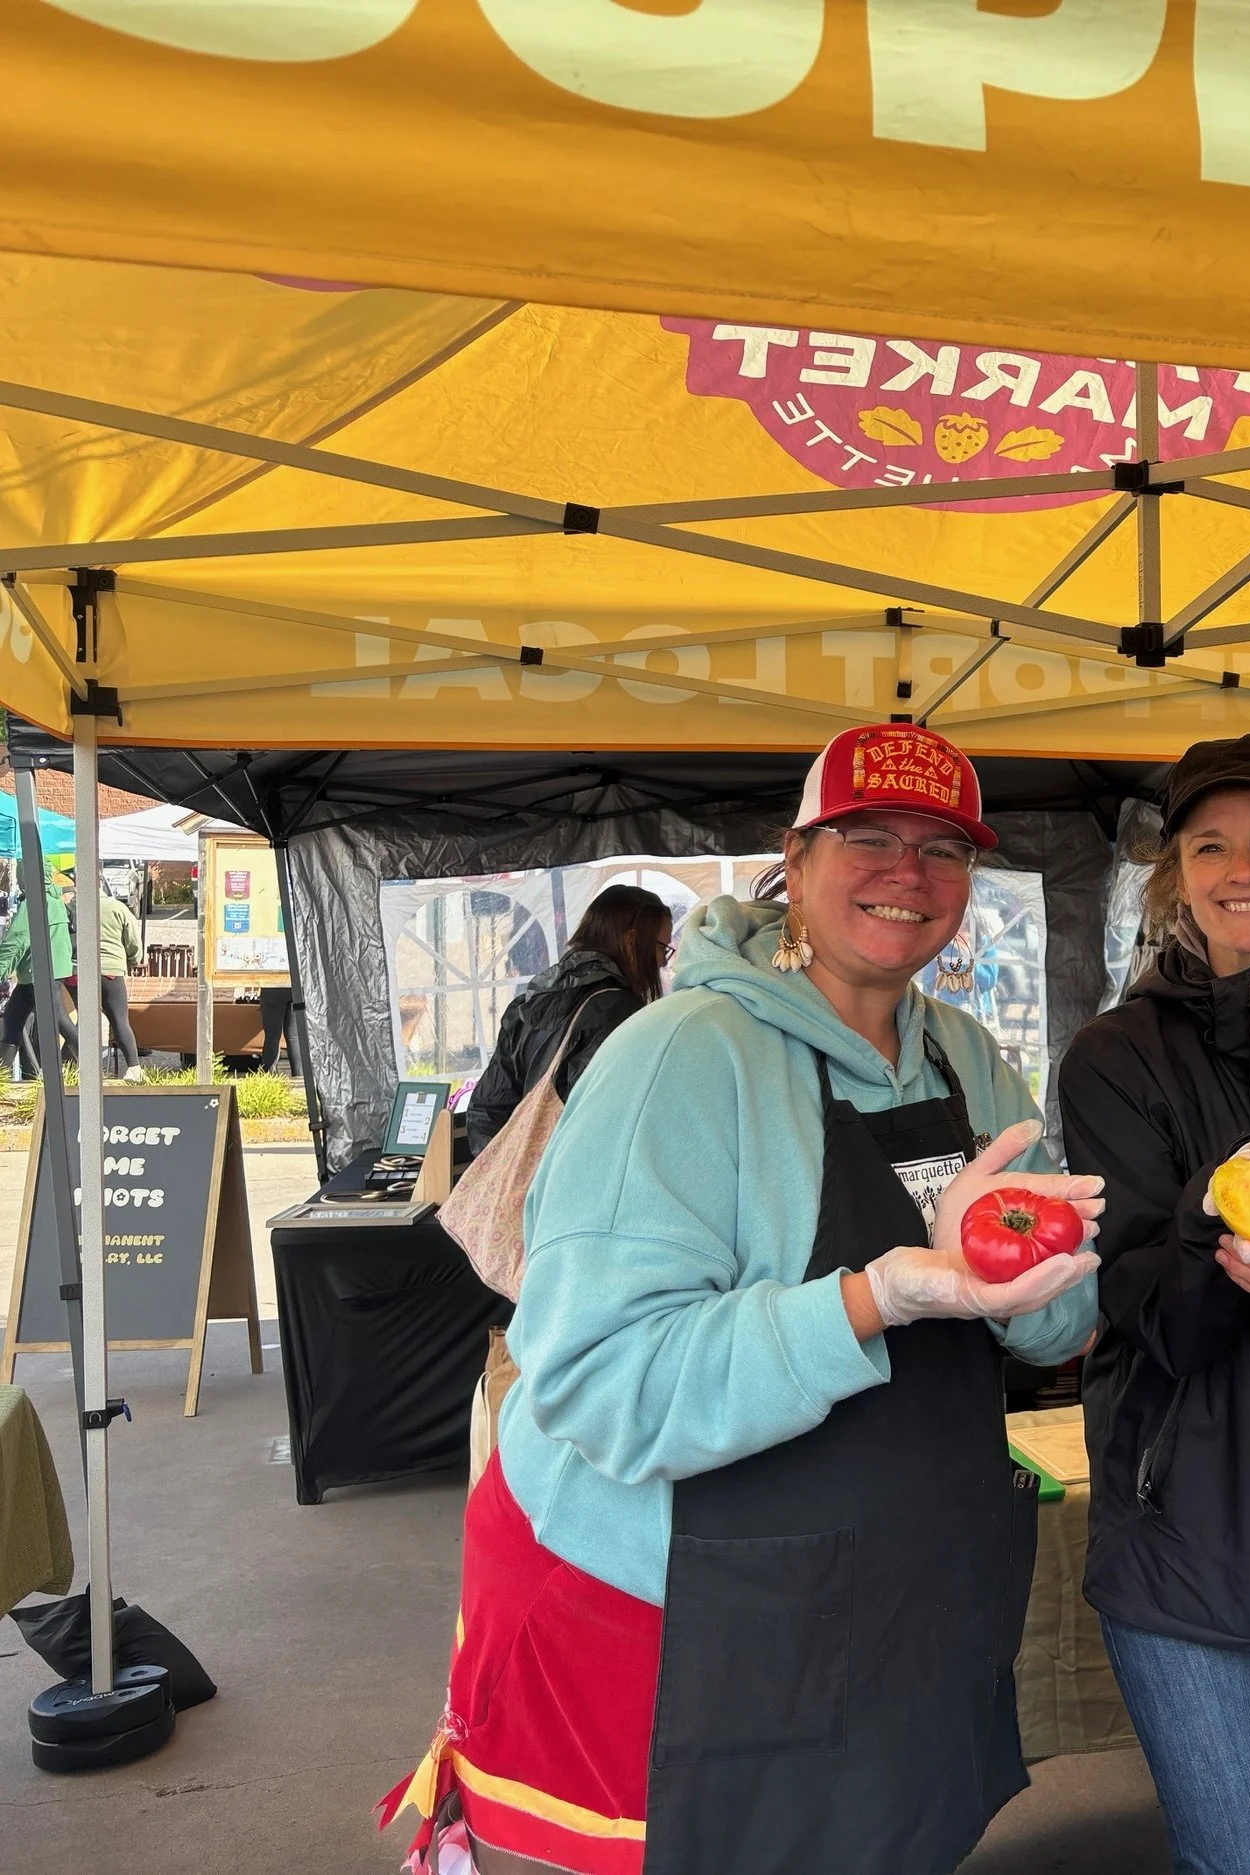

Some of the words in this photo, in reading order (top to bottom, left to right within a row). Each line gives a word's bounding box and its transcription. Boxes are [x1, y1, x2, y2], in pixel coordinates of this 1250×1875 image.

[866, 740, 954, 775] DEFEND
[898, 757, 924, 774] the
[866, 773, 950, 804] SACRED
[103, 1156, 146, 1176] ME
[898, 1160, 962, 1184] marquette
[136, 1253, 163, 1264] LLC
